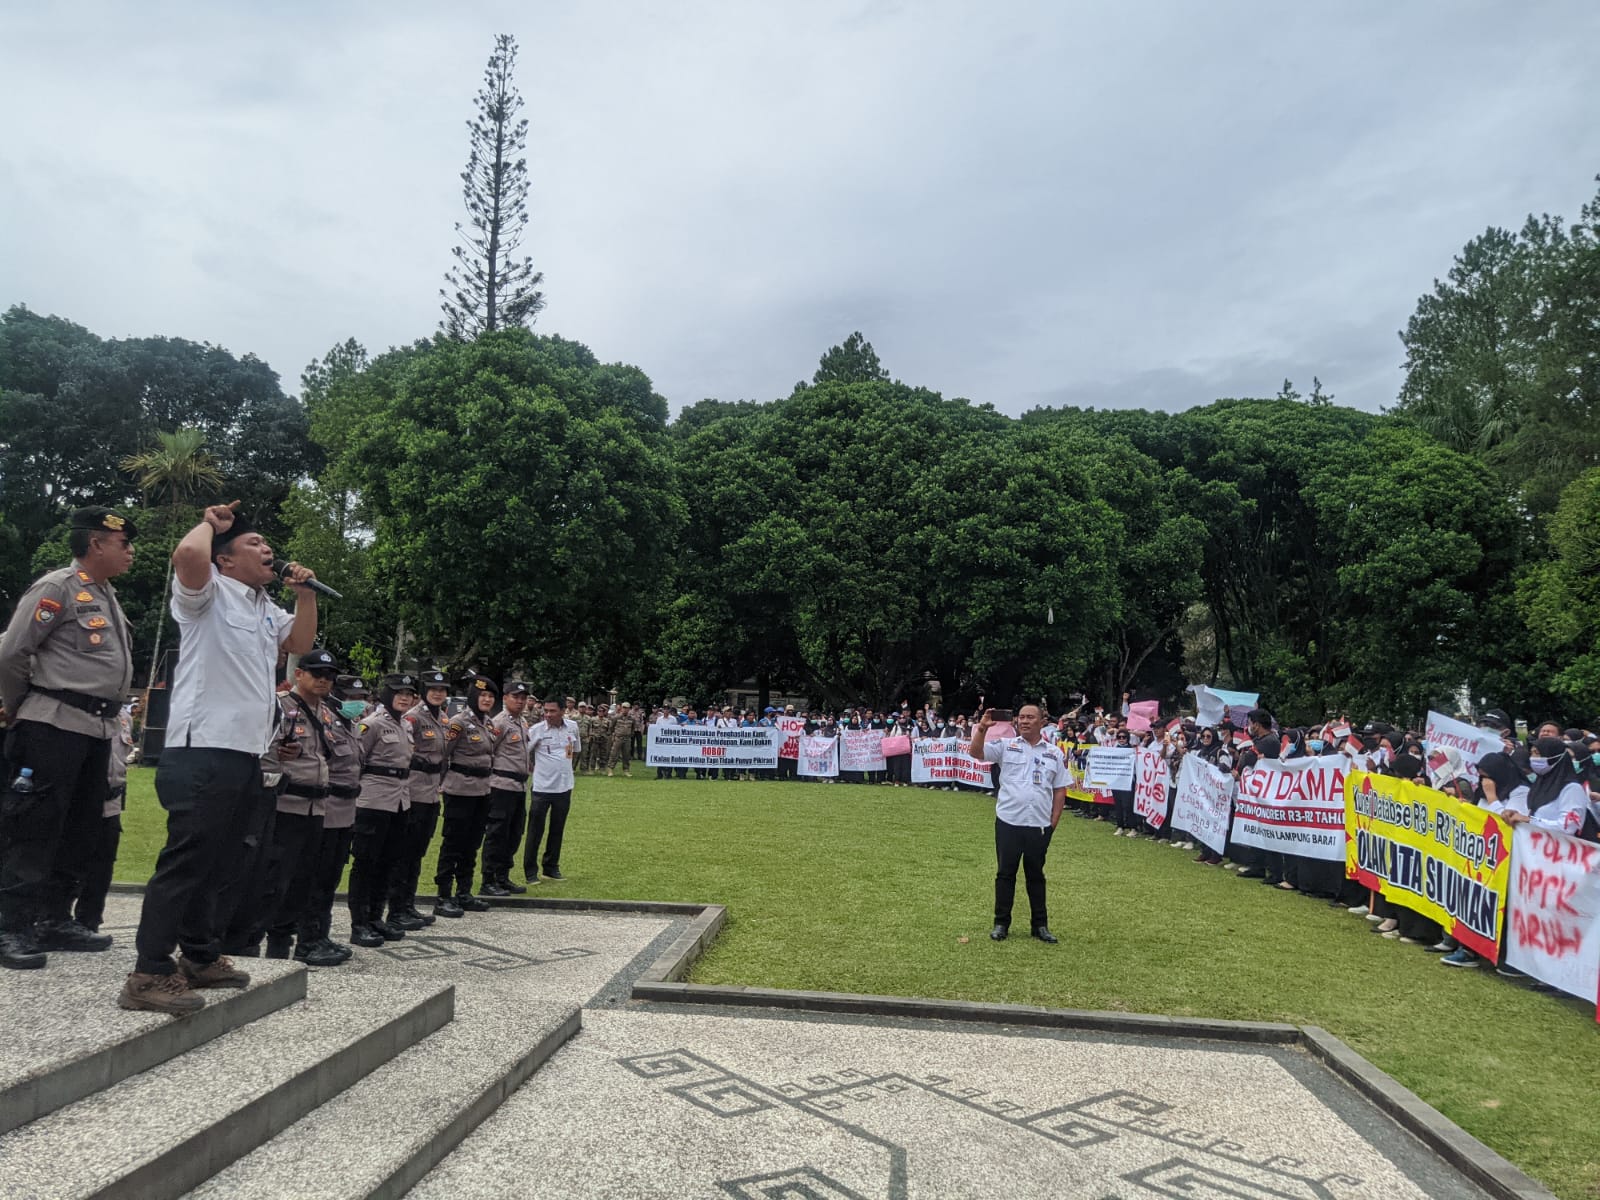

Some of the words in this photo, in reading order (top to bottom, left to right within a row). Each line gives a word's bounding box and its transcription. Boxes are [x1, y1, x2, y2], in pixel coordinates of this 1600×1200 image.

[661, 728, 680, 737] Tolong
[681, 728, 716, 738] Manusiakan
[717, 730, 752, 738] Penghasilan
[655, 737, 672, 745] Karna
[673, 737, 687, 745] Kami
[689, 738, 706, 746] Punya
[739, 738, 753, 746] Kami
[702, 747, 726, 756] ROBOT
[931, 768, 958, 778] Paruh
[1275, 767, 1345, 801] DAMA
[1275, 830, 1310, 844] LAMPUNG
[1311, 834, 1336, 846] BARAT
[1413, 801, 1428, 836] R3
[1435, 810, 1450, 846] R2
[1487, 833, 1498, 869] 1
[1530, 832, 1597, 873] TOLAK
[1512, 908, 1582, 958] PARUH
